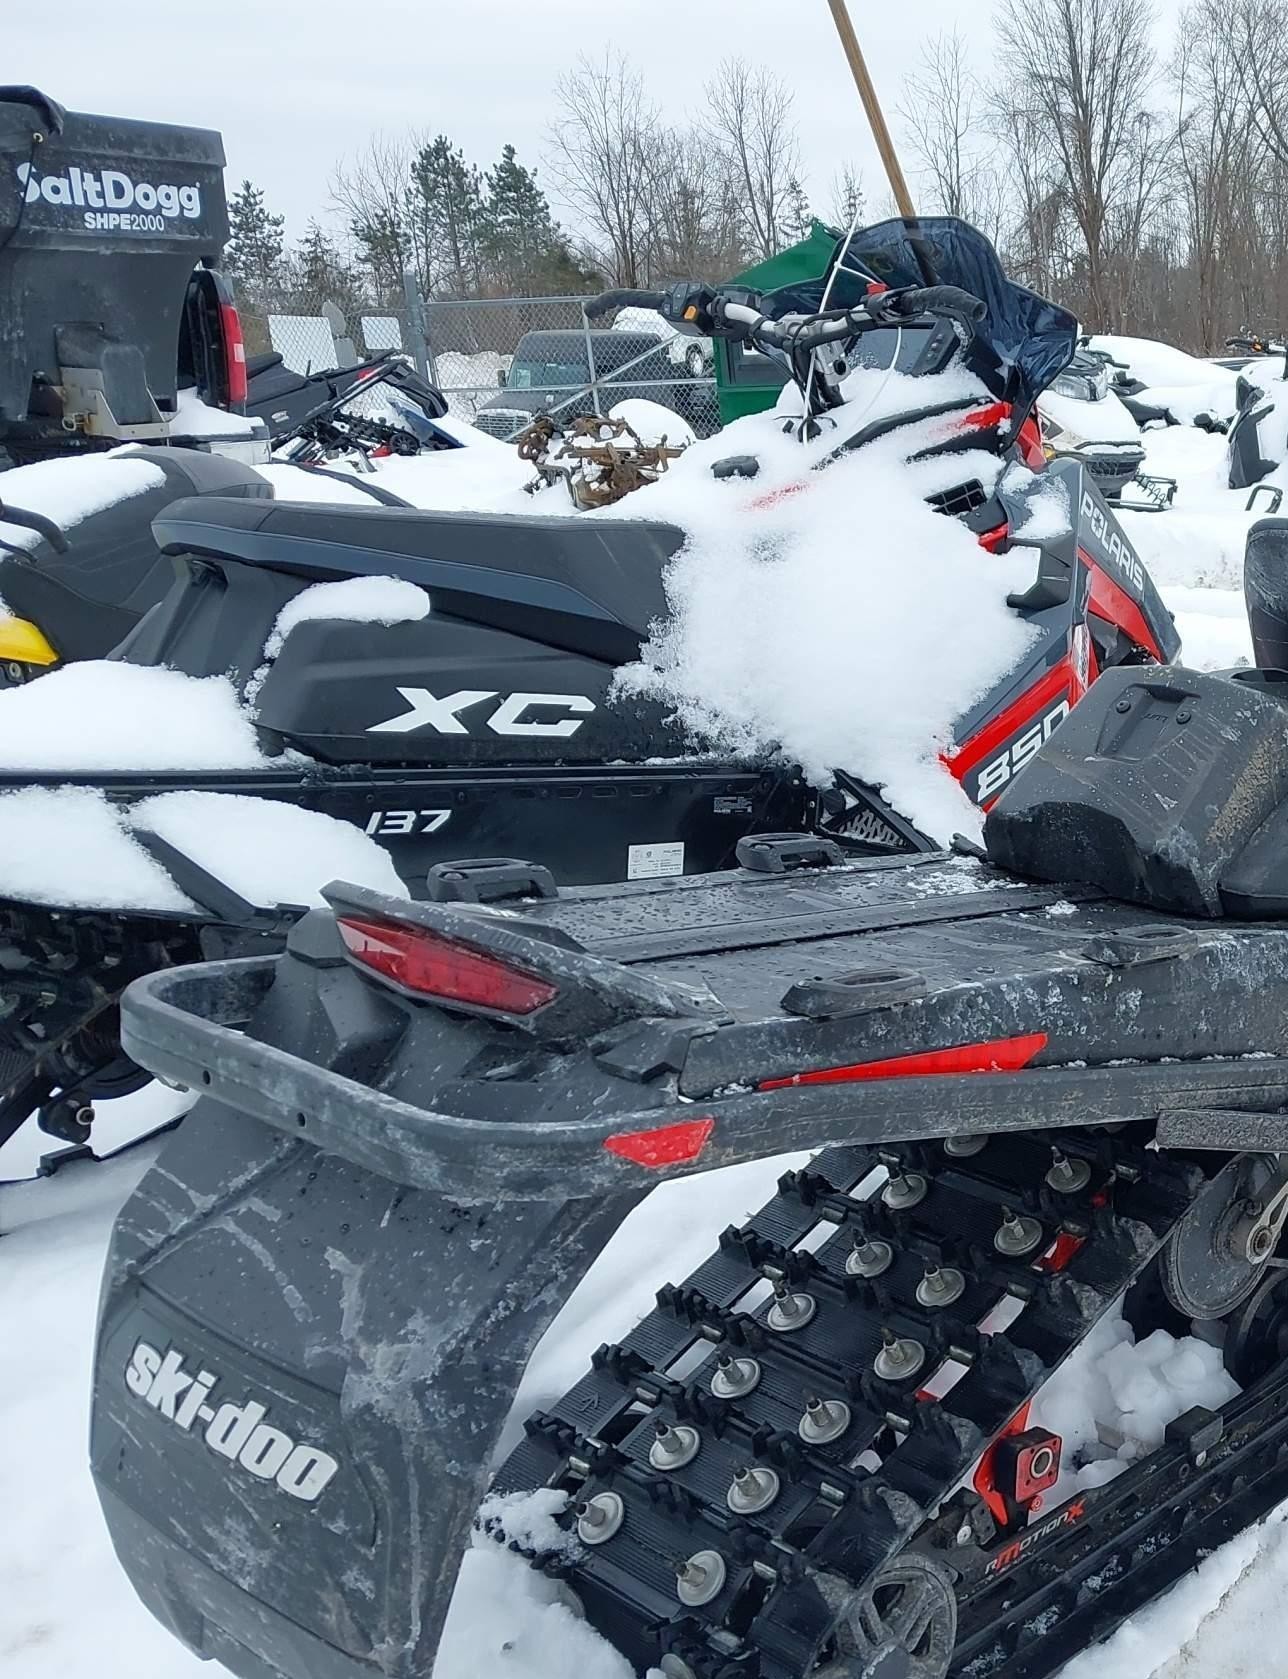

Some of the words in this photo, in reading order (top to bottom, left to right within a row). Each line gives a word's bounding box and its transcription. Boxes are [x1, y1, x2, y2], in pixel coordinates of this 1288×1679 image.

[16, 162, 201, 218] SaltDogg
[84, 212, 165, 231] SHPE2000
[1080, 490, 1144, 591] POLARIS
[364, 686, 597, 737] XC
[365, 809, 452, 835] 137
[125, 1343, 338, 1501] ski-doo
